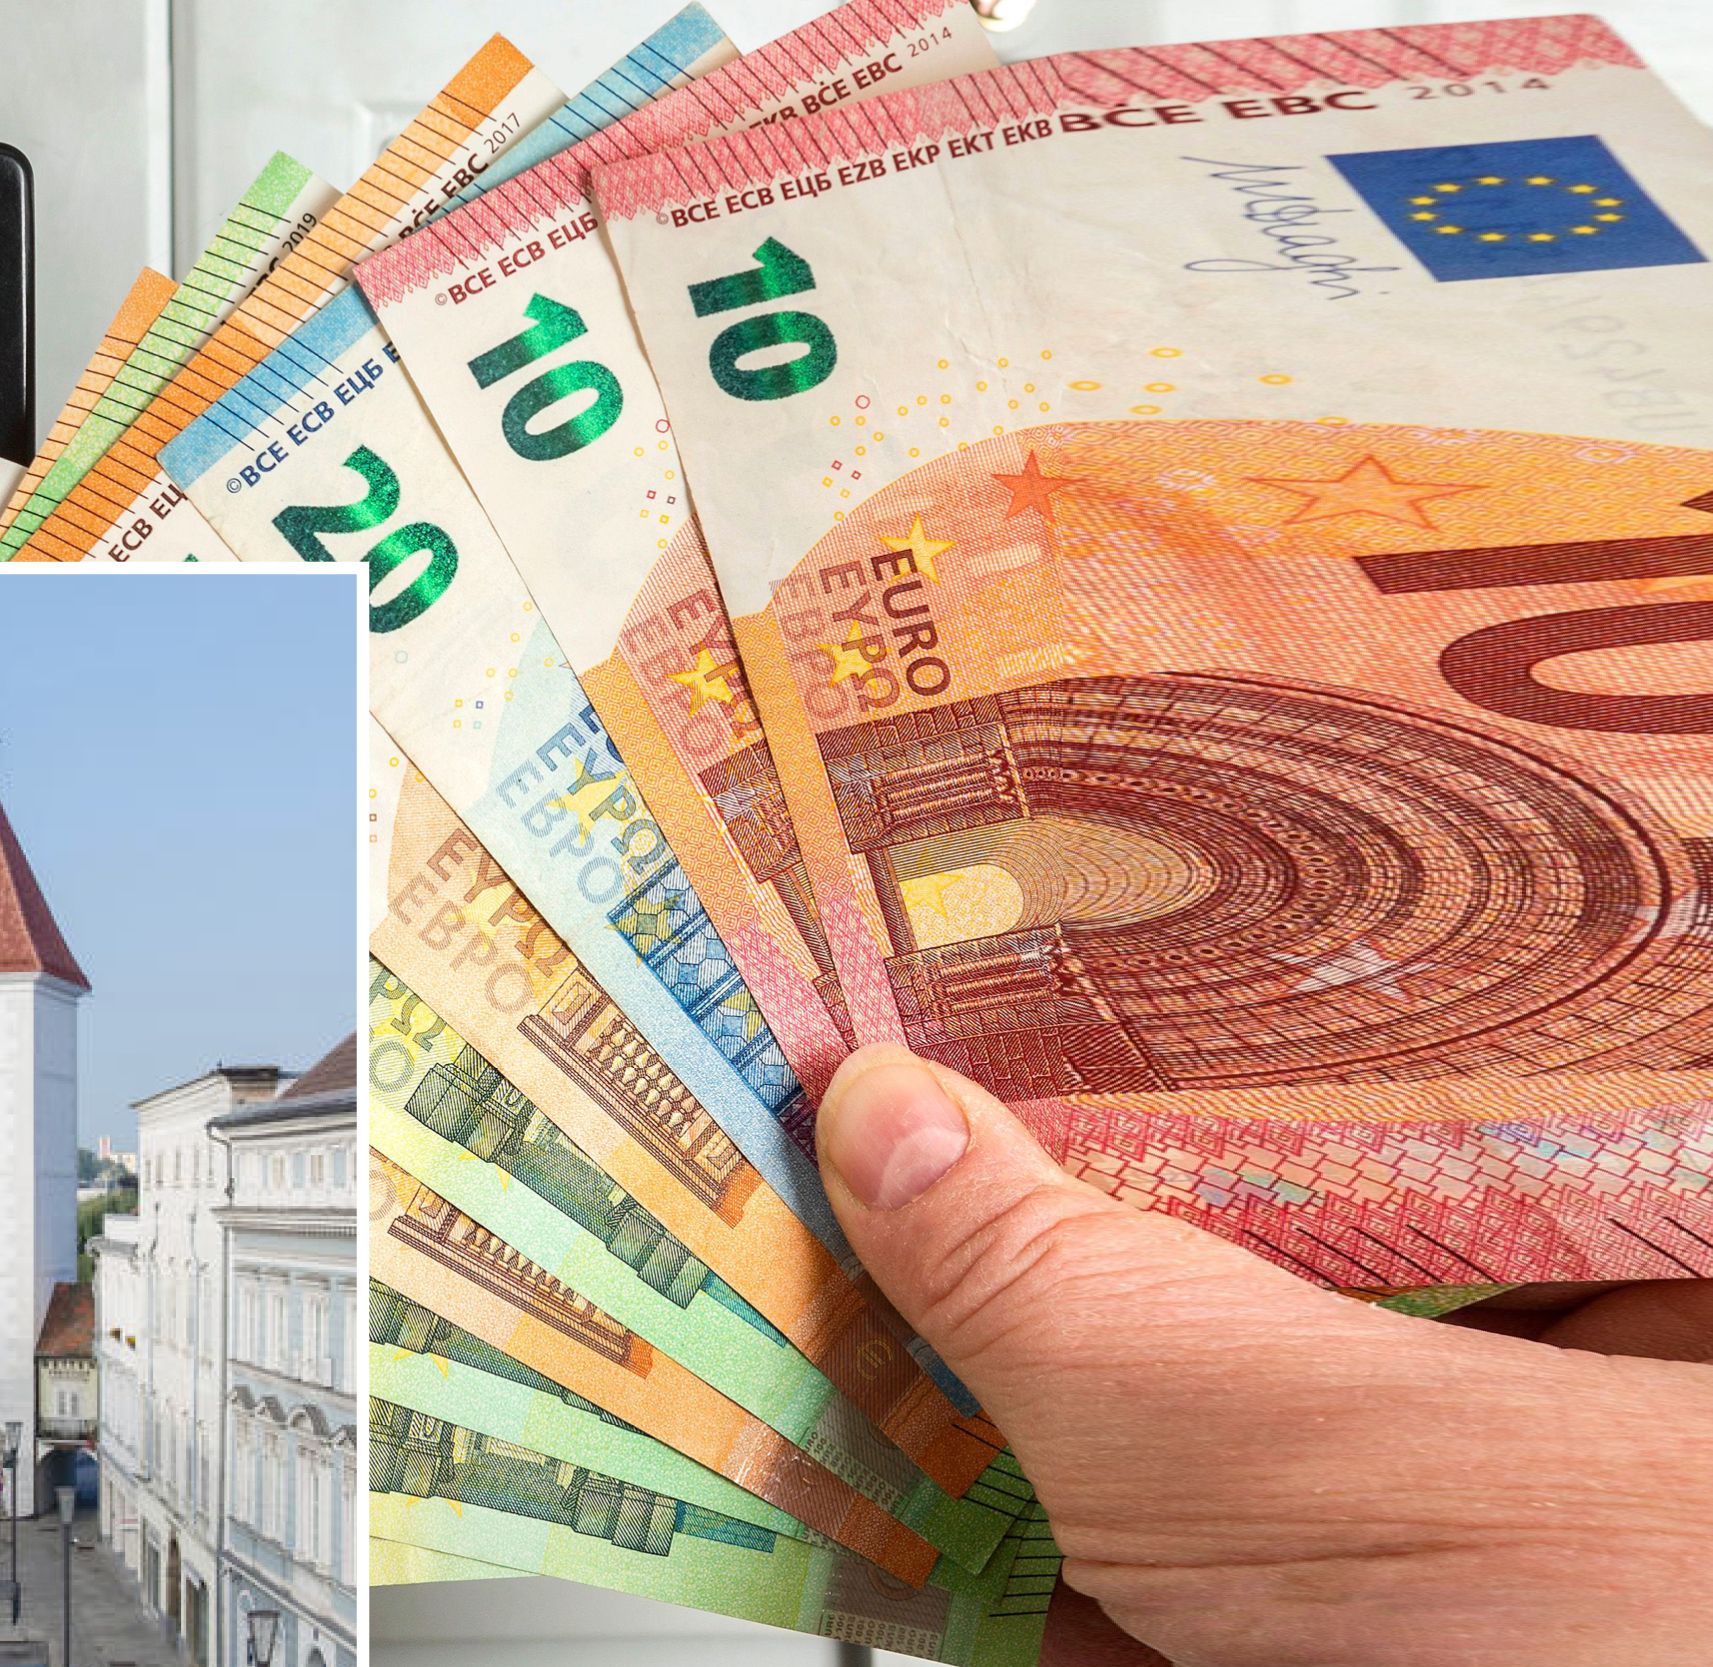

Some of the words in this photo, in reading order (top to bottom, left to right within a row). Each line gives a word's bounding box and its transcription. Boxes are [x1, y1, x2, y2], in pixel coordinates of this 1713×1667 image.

[851, 52, 903, 90] EBC
[907, 26, 953, 58] 2014
[440, 152, 489, 199] EBC
[483, 112, 521, 154] 2017
[725, 187, 775, 216] ECB
[779, 171, 833, 200] ЕЦБ
[837, 158, 888, 187] EZB
[891, 143, 941, 173] EKP
[947, 131, 995, 160] EKT
[1001, 117, 1053, 147] EKB
[1228, 90, 1380, 120] EBC
[1407, 77, 1552, 101] 2014
[281, 212, 318, 252] 2019
[497, 240, 546, 278] ECB
[546, 211, 599, 251] ЕЦБ
[687, 236, 838, 402] 10
[286, 400, 336, 447] ECB
[333, 357, 385, 406] ЕЦБ
[466, 292, 625, 462] 10
[148, 483, 189, 520] ЕЦ
[270, 443, 460, 635] 20
[870, 548, 952, 697] EURO
[1353, 488, 1713, 735] 10
